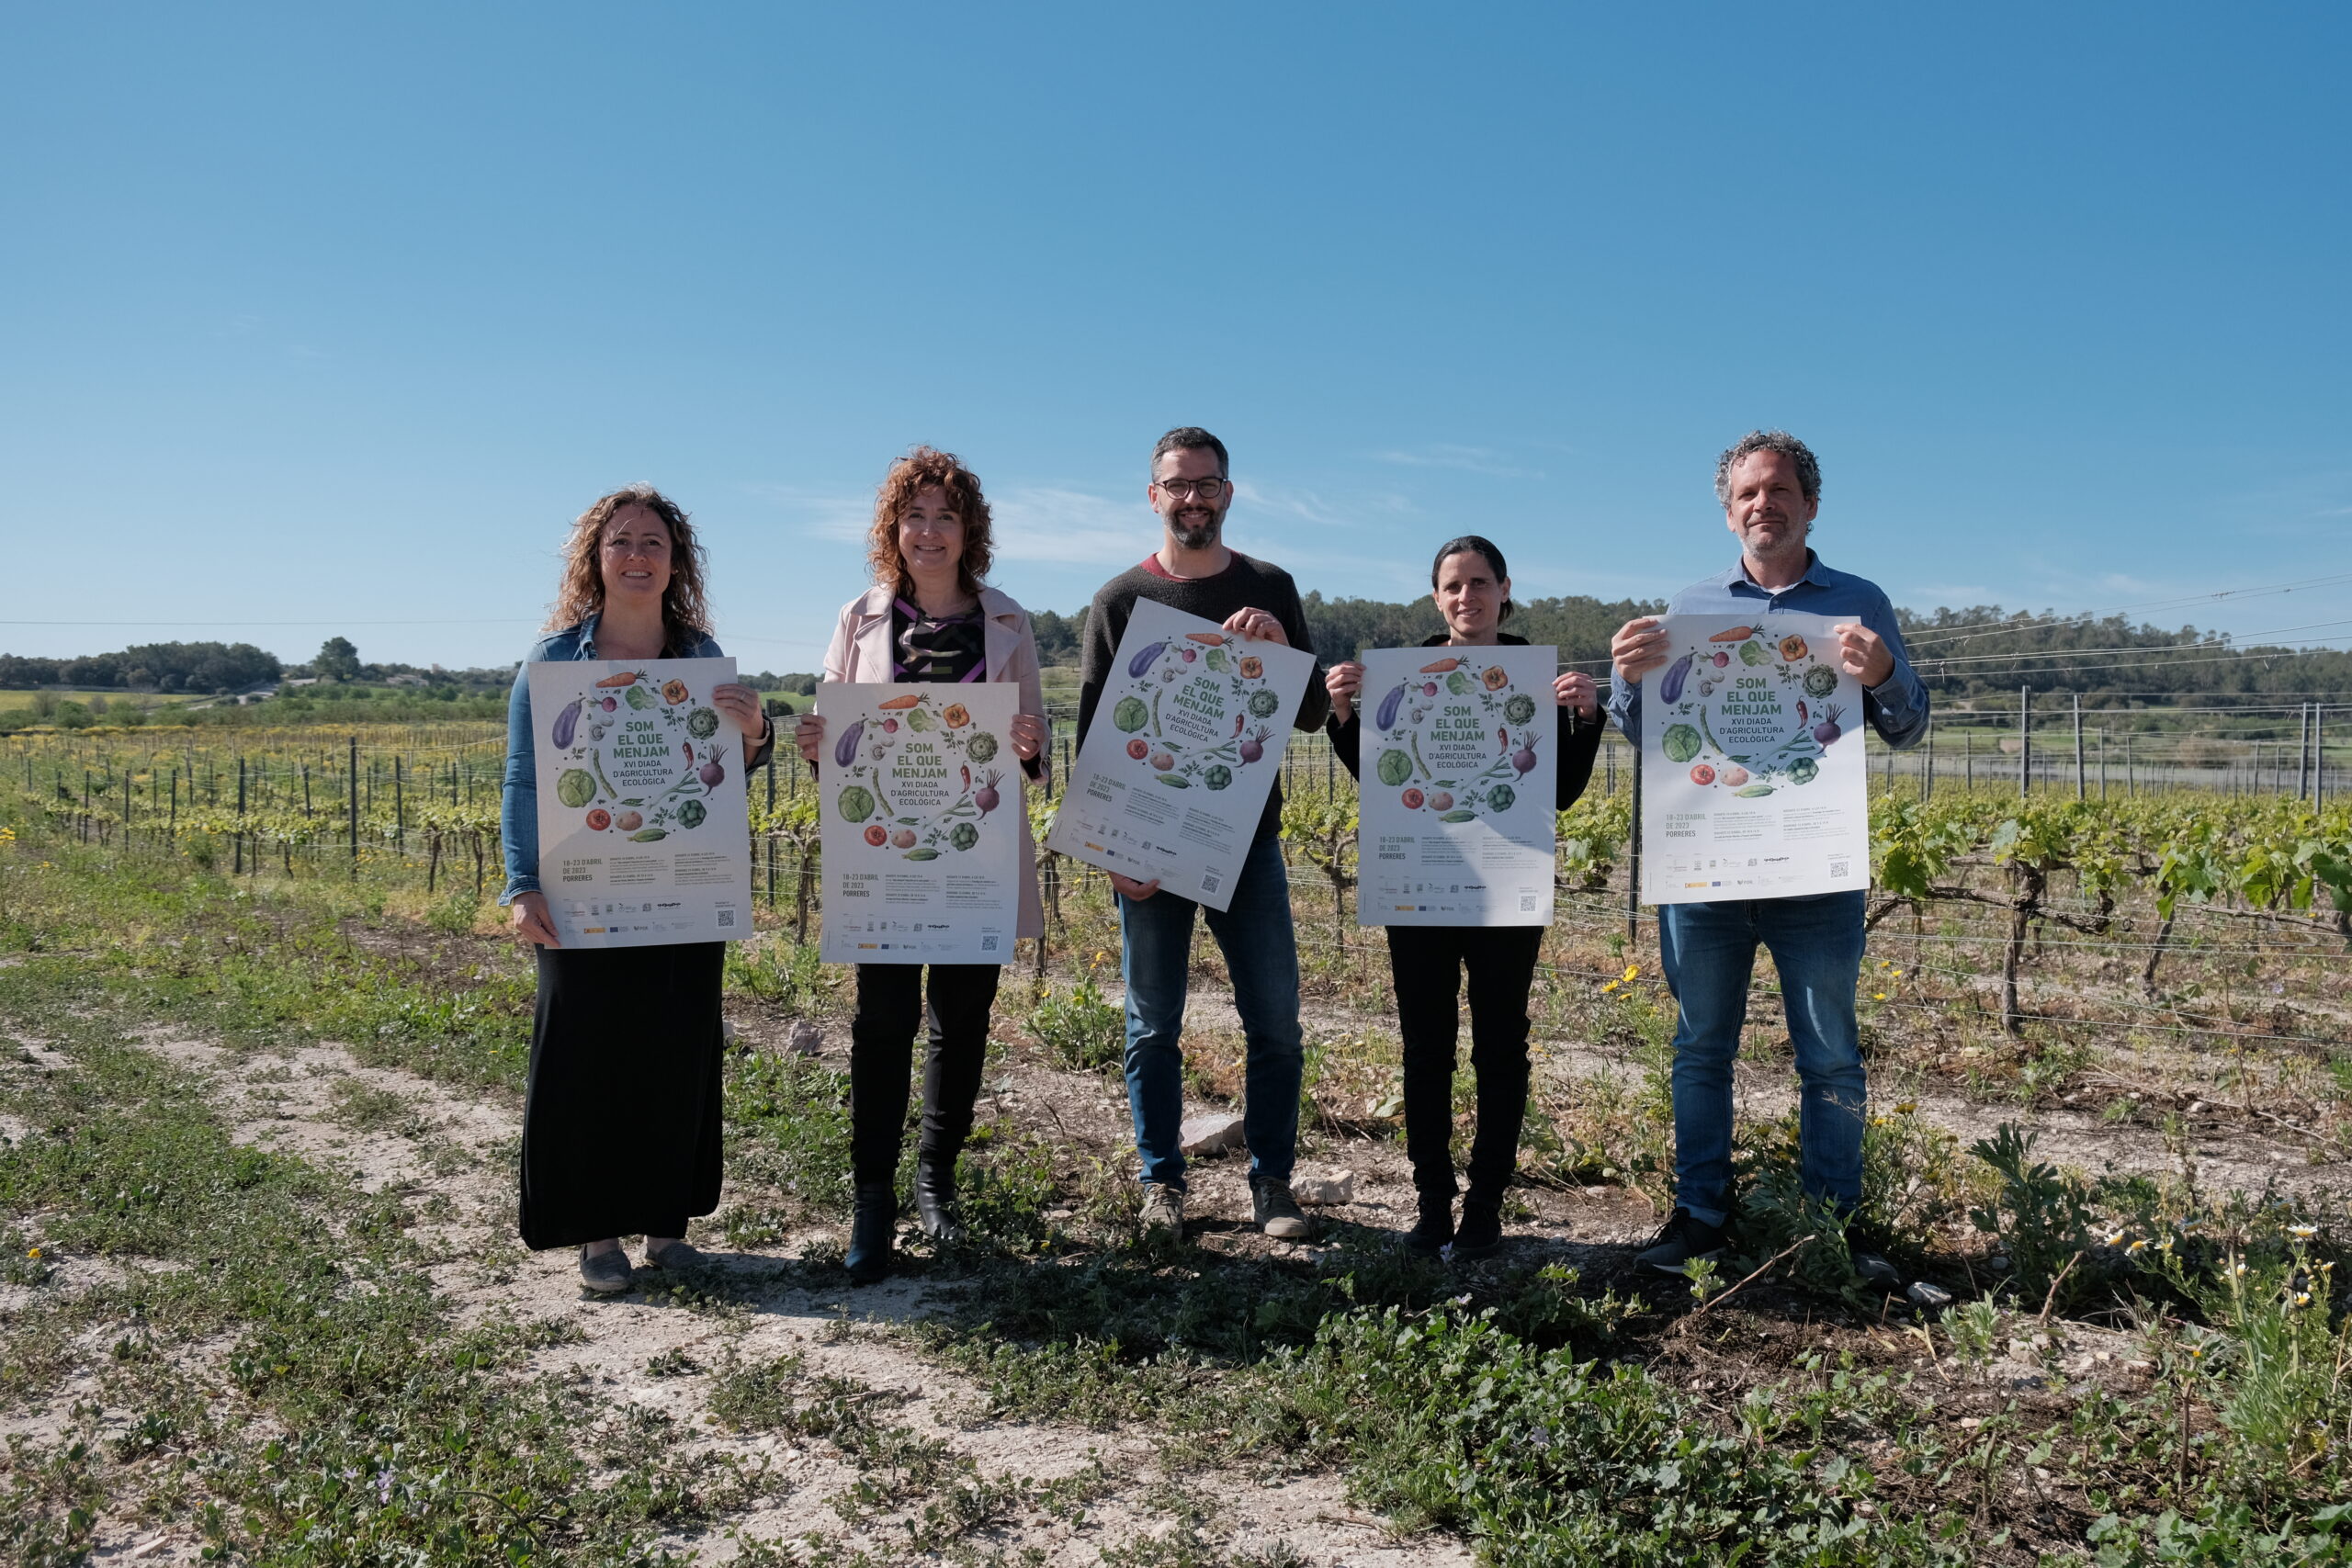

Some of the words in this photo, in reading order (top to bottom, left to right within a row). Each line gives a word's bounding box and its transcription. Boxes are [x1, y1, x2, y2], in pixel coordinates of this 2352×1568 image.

[1194, 677, 1220, 693] SOM
[1736, 678, 1766, 688] SOM
[1182, 685, 1196, 698] EL
[1200, 691, 1224, 707] QUE
[1727, 692, 1743, 702] EL
[1748, 691, 1775, 702] QUE
[1173, 694, 1225, 720] MENJAM
[1444, 706, 1471, 716] SOM
[1721, 704, 1781, 715] MENJAM
[1178, 709, 1189, 717] XVI
[1191, 713, 1211, 726] DIADA
[626, 721, 654, 732] SOM
[1166, 713, 1218, 737] D'AGRICULTURA
[1436, 719, 1451, 728] EL
[1454, 719, 1480, 728] QUE
[618, 735, 634, 745] EL
[638, 734, 663, 745] QUE
[1431, 731, 1485, 741] MENJAM
[613, 746, 669, 758] MENJAM
[905, 743, 933, 753] SOM
[897, 756, 912, 765] EL
[916, 756, 942, 765] QUE
[613, 769, 673, 777] D'AGRICULTURA
[893, 768, 947, 778] MENJAM
[1087, 789, 1112, 802] PORRERES
